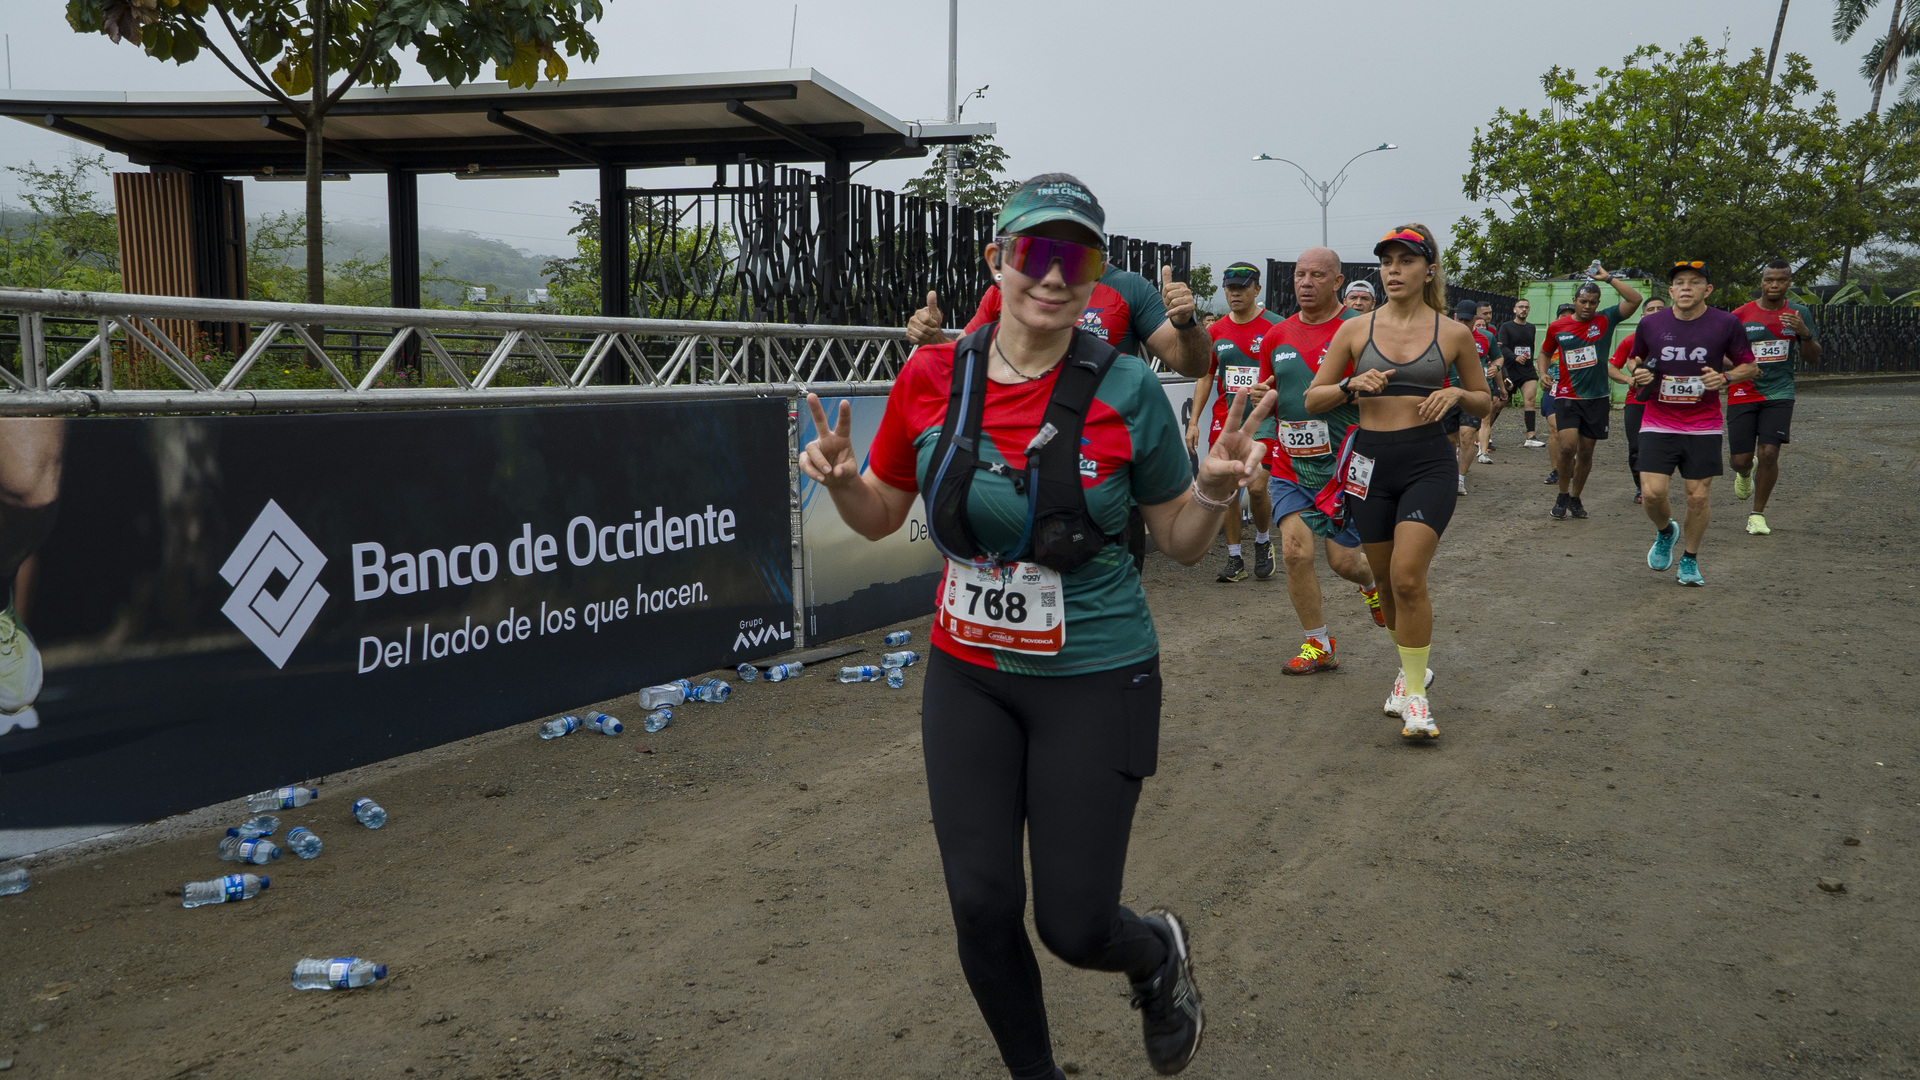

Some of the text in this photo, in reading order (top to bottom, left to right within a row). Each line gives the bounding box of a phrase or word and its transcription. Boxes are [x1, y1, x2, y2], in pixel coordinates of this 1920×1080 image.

[1037, 188, 1060, 196] TRES
[1761, 346, 1780, 356] 345
[1575, 354, 1587, 363] 24
[1233, 375, 1253, 386] 985
[1670, 384, 1694, 395] 194
[1287, 432, 1315, 446] 328
[351, 504, 737, 602] Banco de Occidente
[965, 583, 1027, 624] 768
[358, 581, 709, 674] Del lado de los que hacen.
[738, 617, 764, 630] Grupo
[732, 621, 792, 653] AVAL
